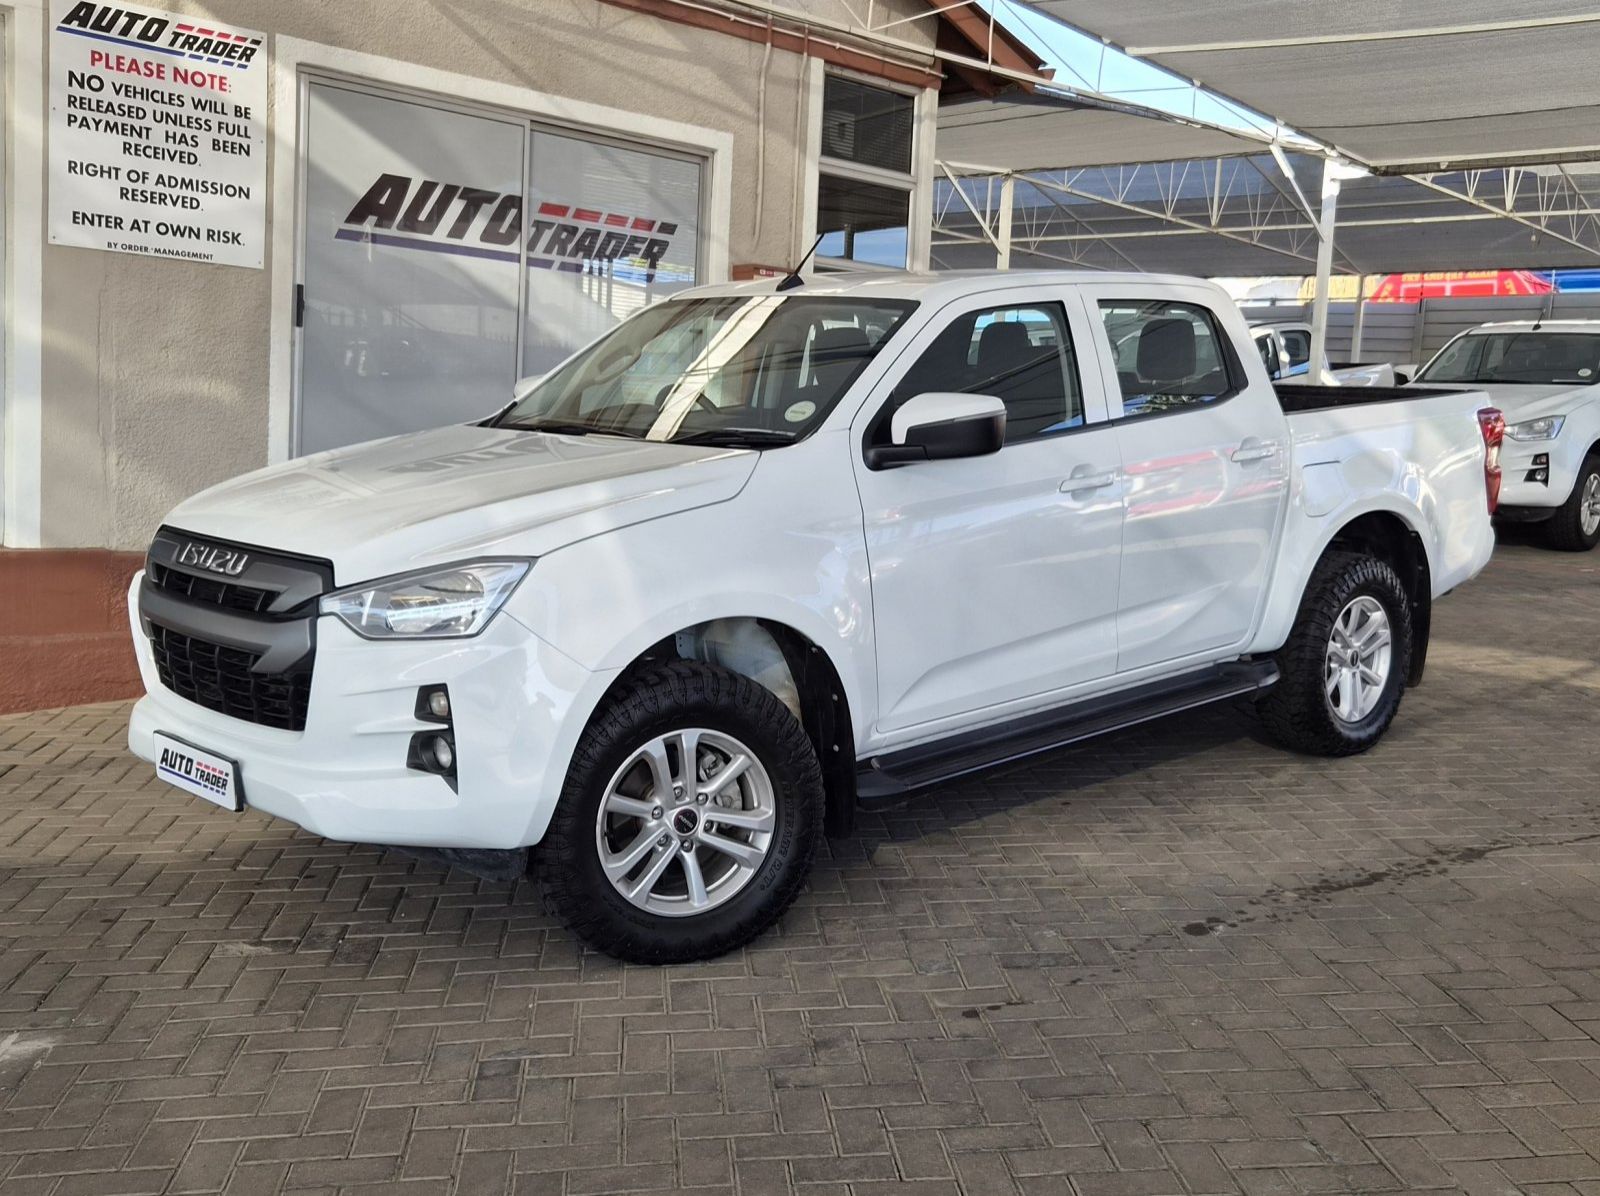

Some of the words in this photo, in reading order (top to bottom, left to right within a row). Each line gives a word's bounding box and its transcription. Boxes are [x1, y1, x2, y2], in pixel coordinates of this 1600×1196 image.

[61, 1, 170, 43] AUTO
[168, 31, 258, 63] TRADER
[90, 50, 165, 80] PLEASE
[173, 66, 232, 93] NOTE:
[67, 70, 104, 92] NO
[111, 82, 185, 108] VEHICLES
[191, 97, 228, 116] WILL
[234, 105, 251, 120] BE
[67, 94, 147, 120] RELEASED
[152, 109, 212, 132] UNLESS
[217, 122, 251, 139] FULL
[67, 113, 152, 140] PAYMENT
[164, 130, 199, 148] HAS
[212, 138, 251, 157] BEEN
[122, 141, 202, 167] RECEIVED.
[67, 160, 121, 181] RIGHT
[126, 169, 150, 185] OF
[155, 174, 251, 200] ADMISSION
[119, 187, 204, 211] RESERVED.
[72, 210, 124, 231] ENTER
[129, 218, 151, 234] AT
[155, 222, 201, 240] OWN
[206, 229, 246, 246] RISK.
[344, 172, 523, 247] AUTO
[525, 219, 671, 271] TRADER
[107, 241, 118, 249] BY
[153, 247, 214, 260] MANAGEMENT
[179, 541, 249, 576] ISUZU
[159, 747, 194, 775] AUTO
[195, 766, 229, 791] TRADER
